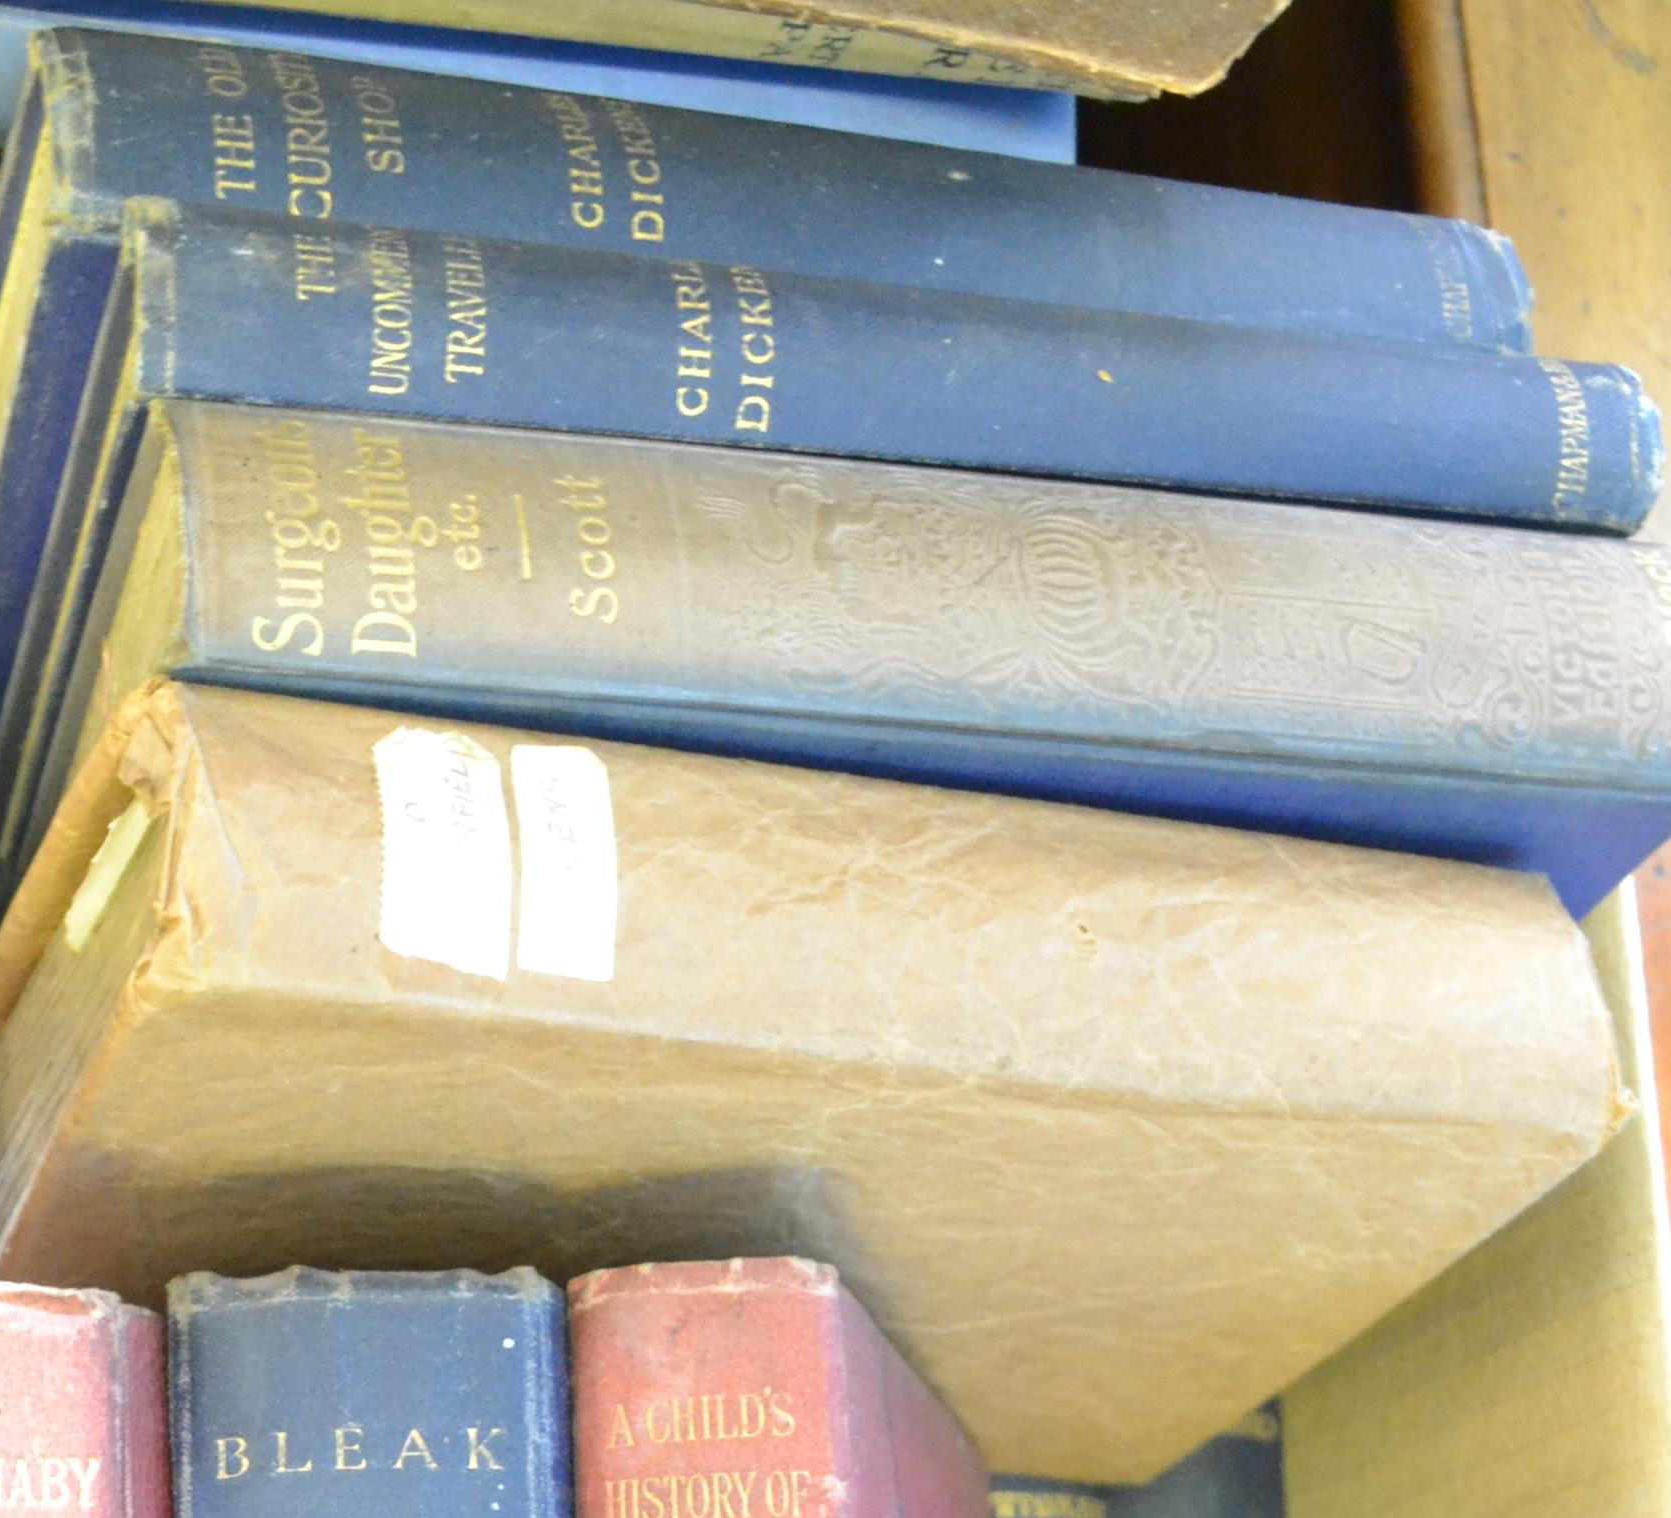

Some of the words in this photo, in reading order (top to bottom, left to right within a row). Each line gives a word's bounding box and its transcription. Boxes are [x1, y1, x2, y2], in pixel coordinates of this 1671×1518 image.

[212, 112, 257, 200] THE
[665, 259, 713, 418] CHARL
[341, 427, 438, 658] Daughter
[441, 494, 484, 572] etc.
[552, 474, 620, 626] Scott
[215, 1427, 506, 1480] BLEAK
[606, 1403, 635, 1449] A
[645, 1386, 797, 1444] CHILD'S
[766, 1470, 810, 1518] OF
